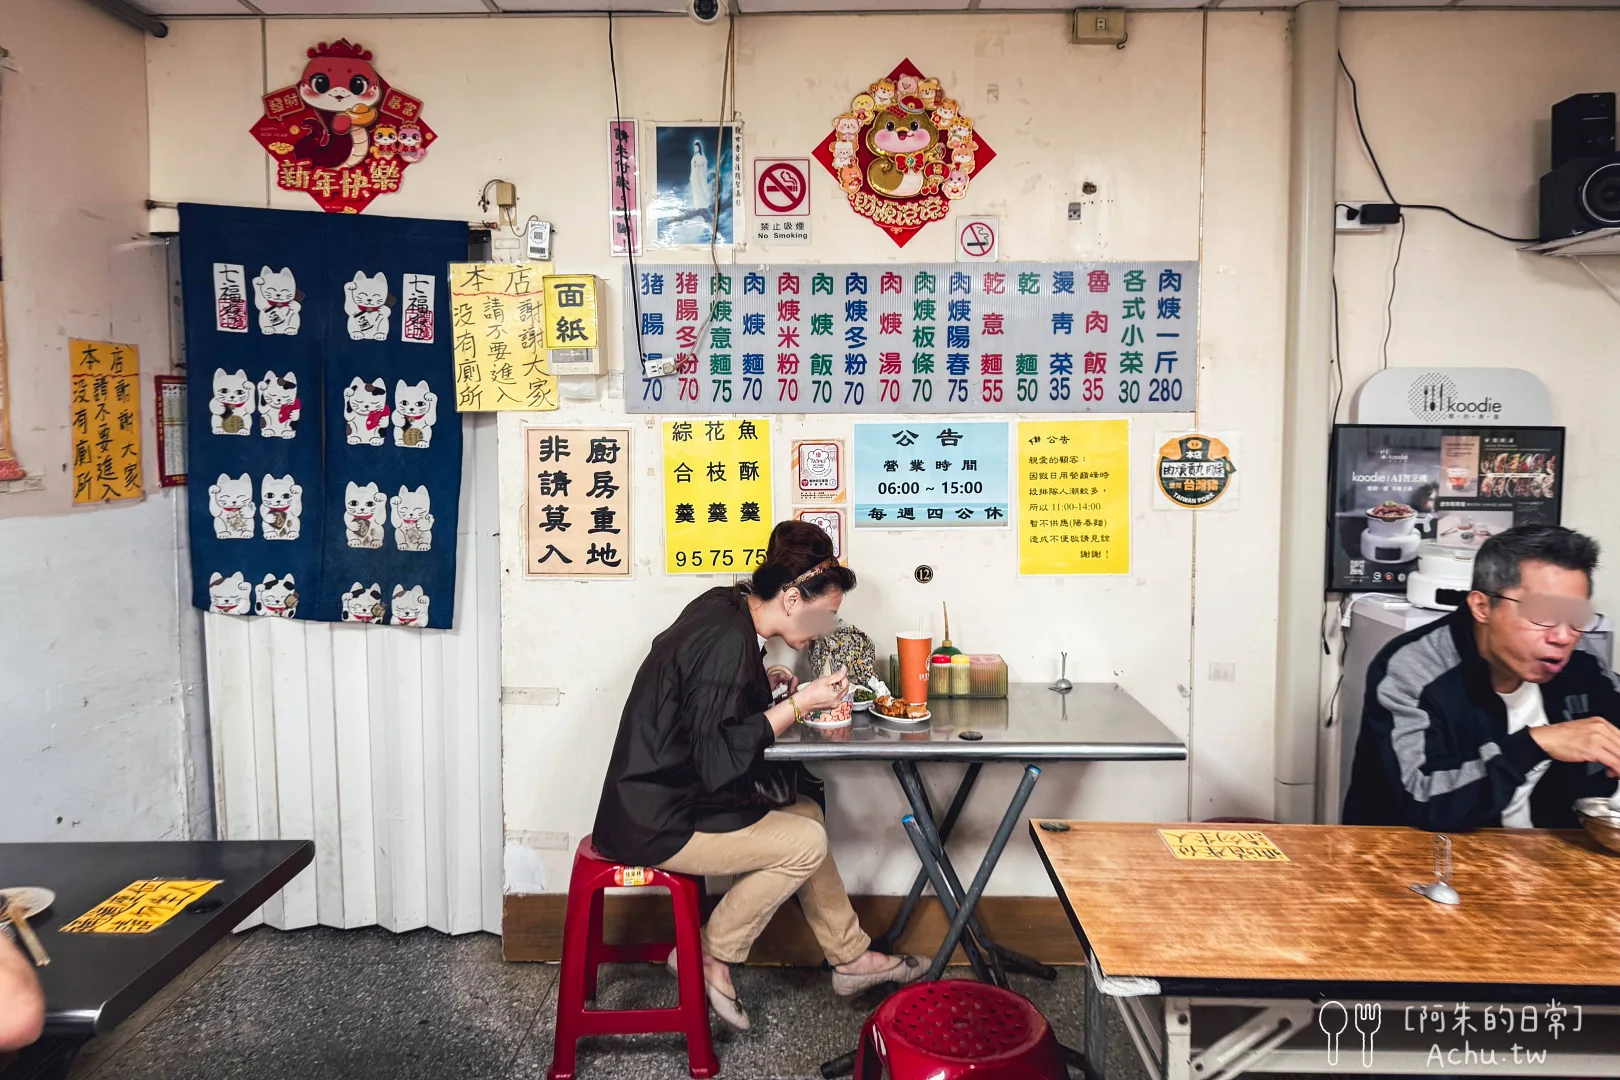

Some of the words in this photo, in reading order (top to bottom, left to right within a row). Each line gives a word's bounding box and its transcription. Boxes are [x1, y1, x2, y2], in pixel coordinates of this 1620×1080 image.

[279, 158, 401, 199] 新年快樂
[760, 222, 805, 231] 禁止吸煙
[773, 232, 808, 240] Smoking
[460, 265, 533, 295] 本店
[553, 283, 589, 343] 面紙
[981, 272, 1005, 376] 乾意麵
[1084, 270, 1110, 374] 魯肉飯
[1119, 270, 1147, 374] 各式小菜
[80, 344, 125, 373] 本店
[482, 296, 522, 403] 請不要進入
[517, 298, 555, 408] 謝謝大家
[642, 378, 663, 401] 70
[678, 378, 699, 401] 70
[711, 379, 732, 403] 75
[743, 378, 763, 401] 70
[777, 378, 798, 402] 70
[812, 380, 832, 403] 70
[844, 381, 865, 405] 70
[879, 379, 900, 402] 70
[912, 379, 932, 402] 70
[948, 379, 968, 403] 75
[982, 379, 1003, 402] 55
[1017, 379, 1038, 402] 50
[1050, 377, 1070, 401] 35
[1082, 378, 1104, 401] 35
[1118, 380, 1140, 403] 30
[1149, 378, 1182, 402] 280
[1447, 396, 1502, 412] koodie
[93, 374, 121, 499] 請不要進入
[115, 379, 140, 492] 謝謝大家
[891, 428, 964, 447] 公告
[1046, 435, 1071, 444] 公告
[883, 459, 978, 472] 營業時間
[1186, 450, 1203, 459] 本店
[672, 421, 696, 524] 綜合羹
[704, 420, 728, 523] 花枝羹
[738, 419, 760, 522] 魚酥羹
[1352, 471, 1386, 482] koodie
[878, 482, 920, 494] 06:00
[941, 481, 983, 494] 15:00
[1173, 492, 1197, 504] TAIWAN
[1197, 492, 1215, 504] PORK
[538, 435, 573, 564] 非請莫入
[585, 436, 621, 567] 廚房重地
[1053, 503, 1101, 511] 11:00-14:00
[867, 507, 1004, 521] 每週四公休
[1030, 535, 1110, 544] 造成不便敬請見諒
[710, 550, 734, 566] 75
[742, 549, 766, 566] 75
